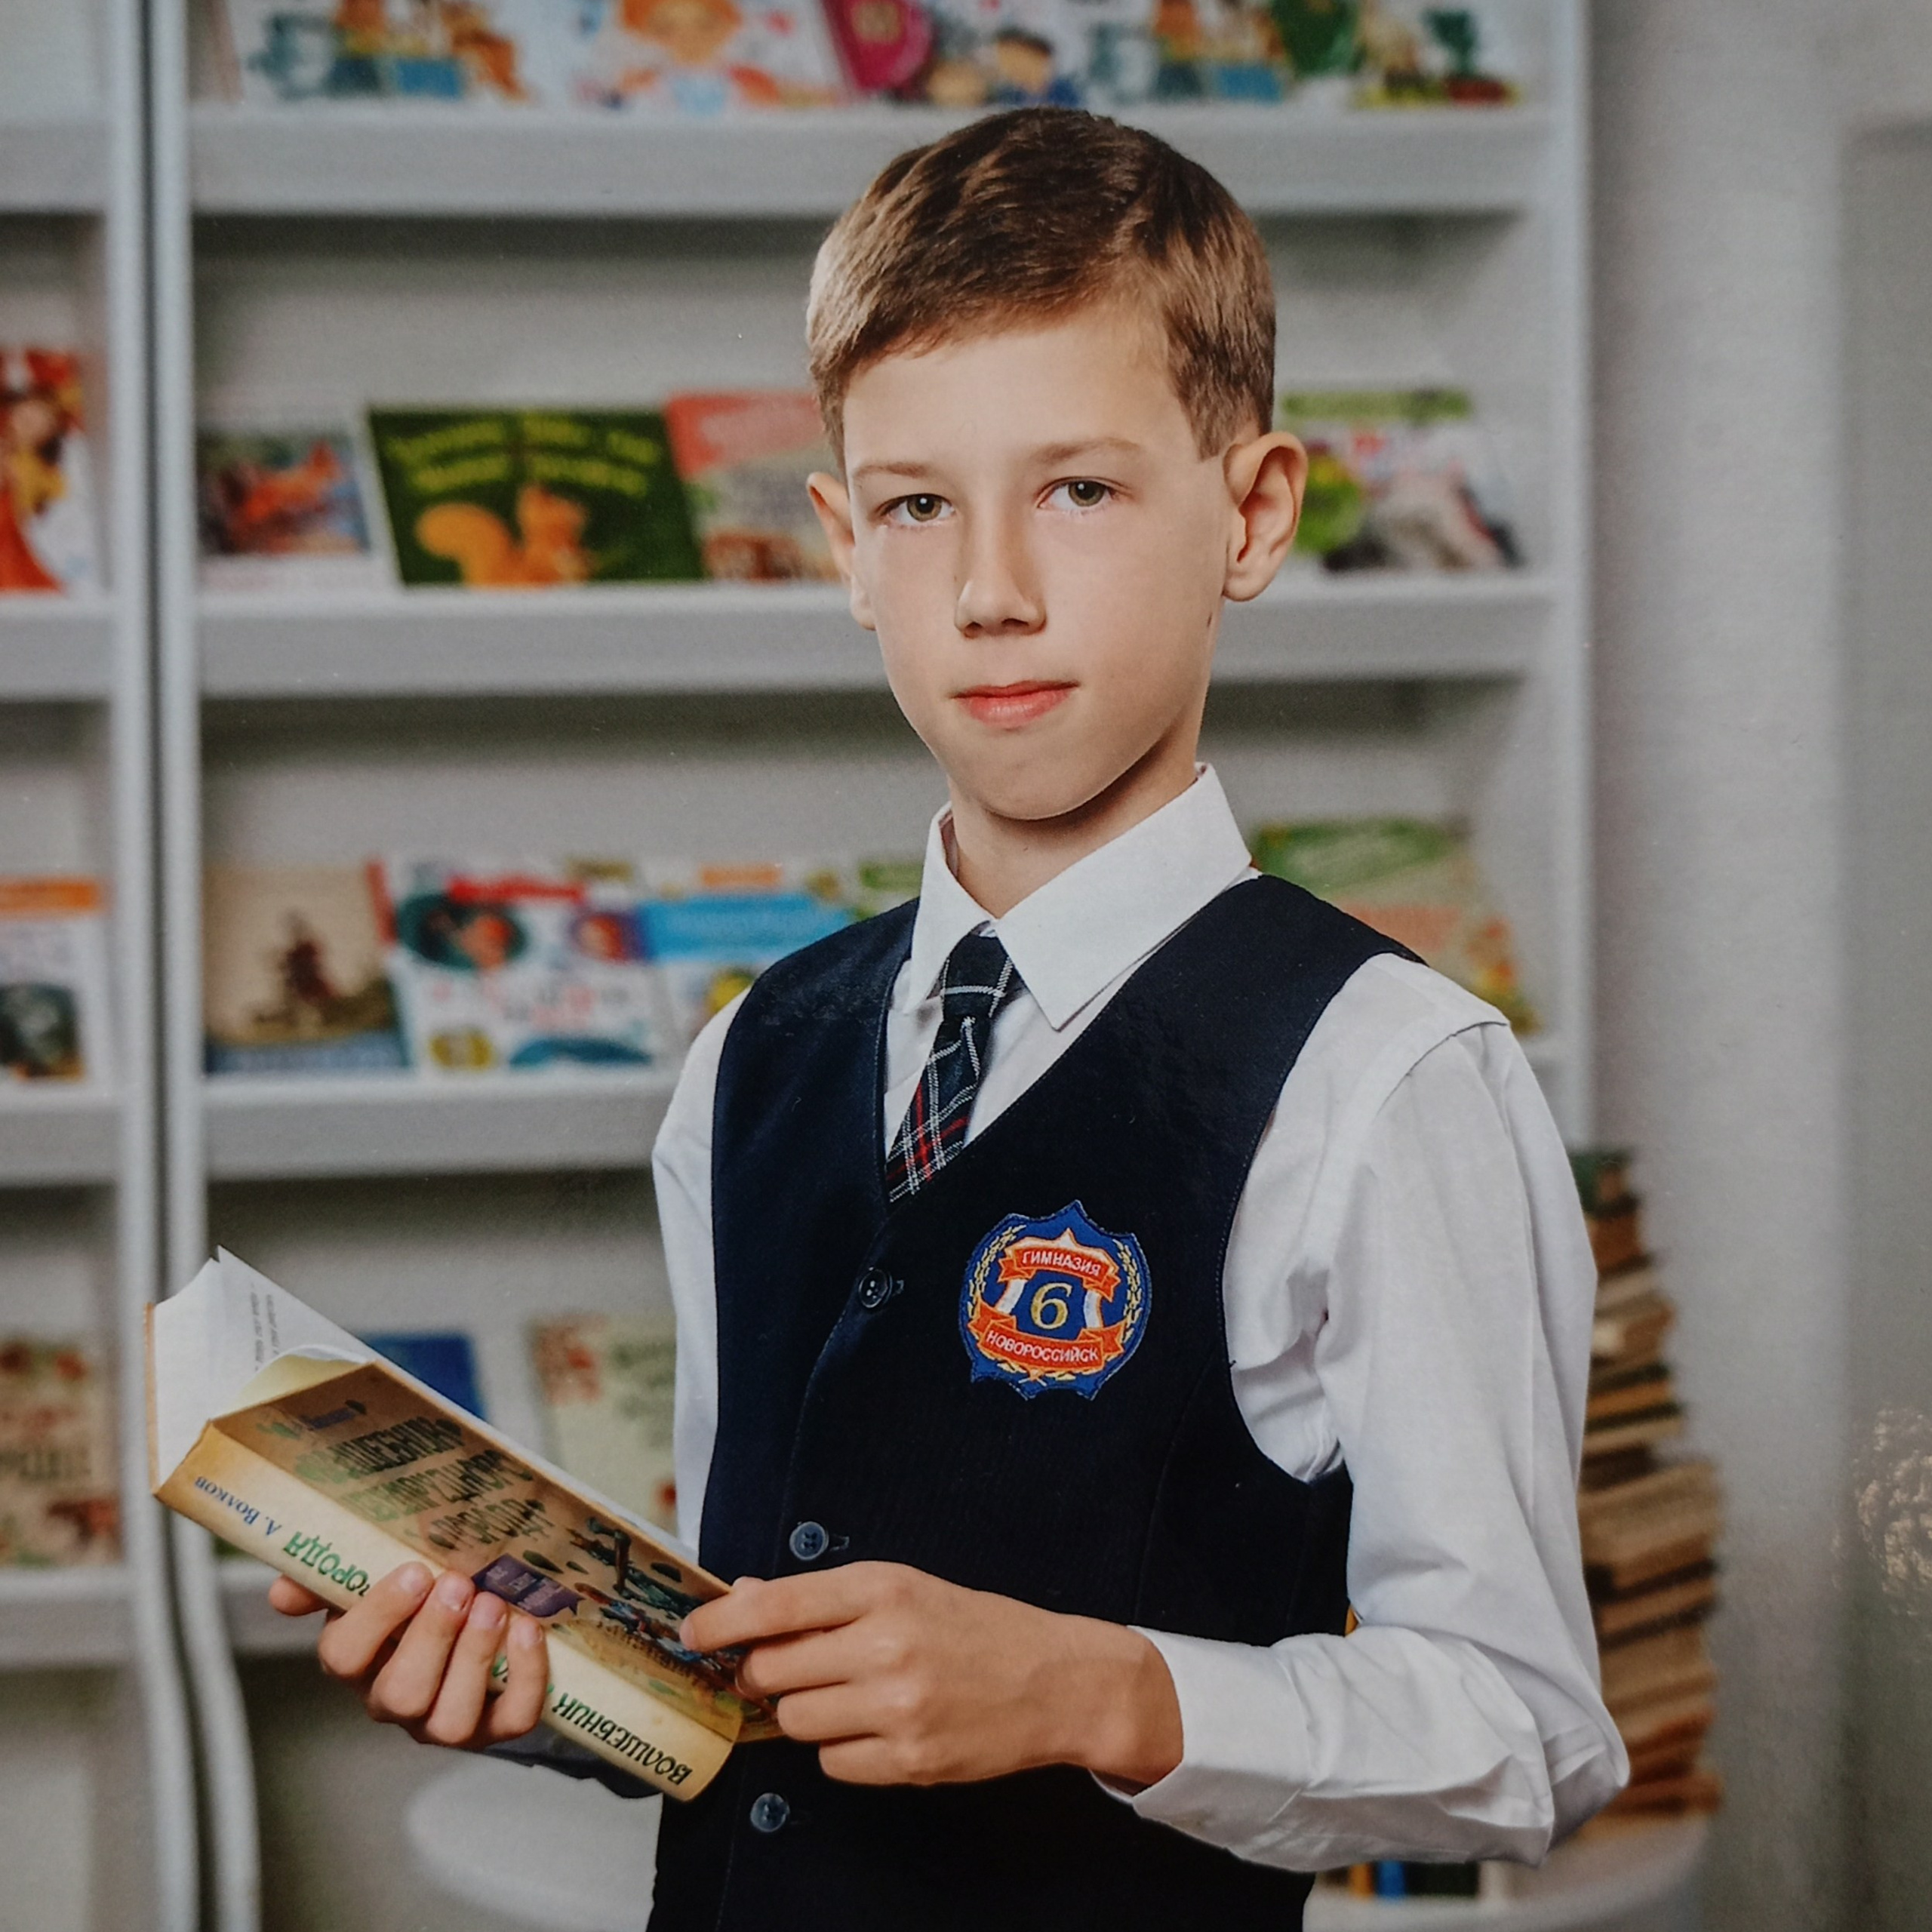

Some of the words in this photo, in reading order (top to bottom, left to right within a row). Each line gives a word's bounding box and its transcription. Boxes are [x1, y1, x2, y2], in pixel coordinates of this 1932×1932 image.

[1022, 1251, 1101, 1275] ГИМНАЗИЯ
[1030, 1282, 1072, 1330] 6
[986, 1330, 1099, 1362] НОВОРОССИЙСК
[265, 1515, 282, 1536] А.
[552, 1693, 694, 1786] ВОЛШЕБНИК
